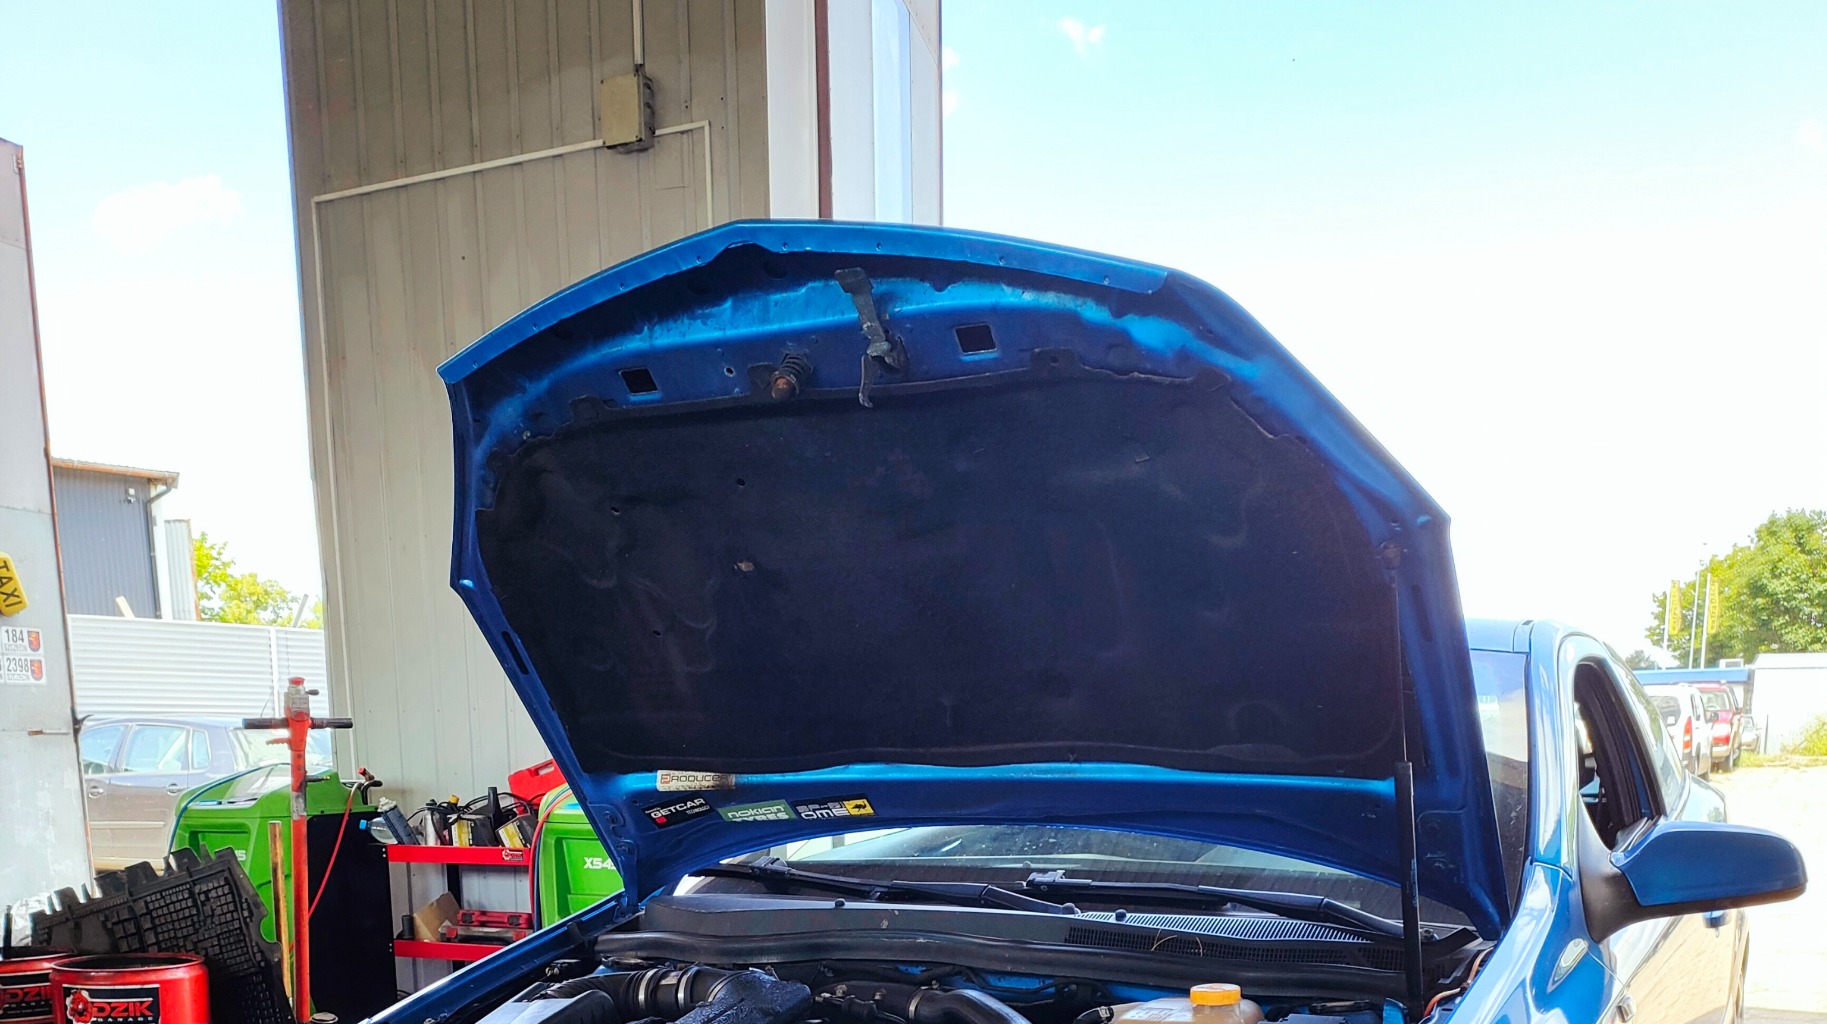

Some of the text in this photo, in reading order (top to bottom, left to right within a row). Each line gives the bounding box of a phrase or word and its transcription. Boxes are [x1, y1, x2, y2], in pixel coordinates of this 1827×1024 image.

[0, 560, 22, 608] TAXI
[5, 629, 24, 643] 184
[6, 657, 29, 672] 2398
[651, 798, 706, 818] GETCAR
[93, 1001, 153, 1017] DZIK
